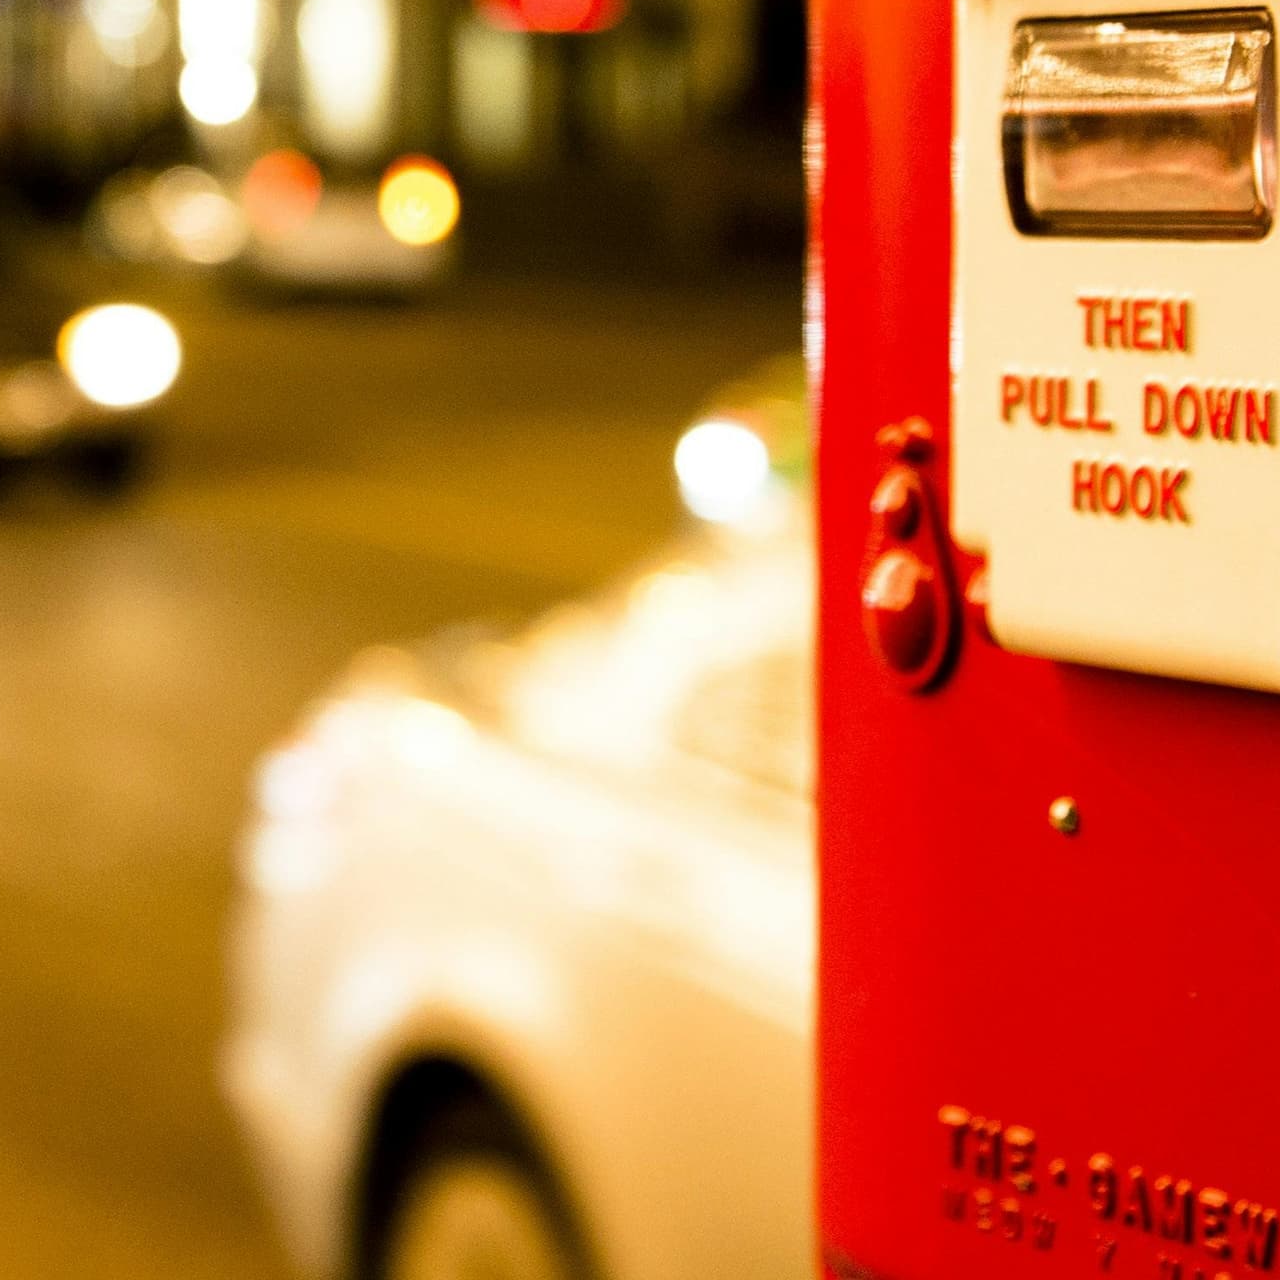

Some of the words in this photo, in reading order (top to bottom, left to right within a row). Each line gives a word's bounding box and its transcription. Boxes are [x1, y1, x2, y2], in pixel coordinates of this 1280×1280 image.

[1076, 296, 1193, 355] THEN
[1001, 374, 1114, 432] PULL
[1142, 382, 1279, 447] DOWN
[1072, 460, 1192, 525] HOOK
[937, 1103, 1037, 1196] THE
